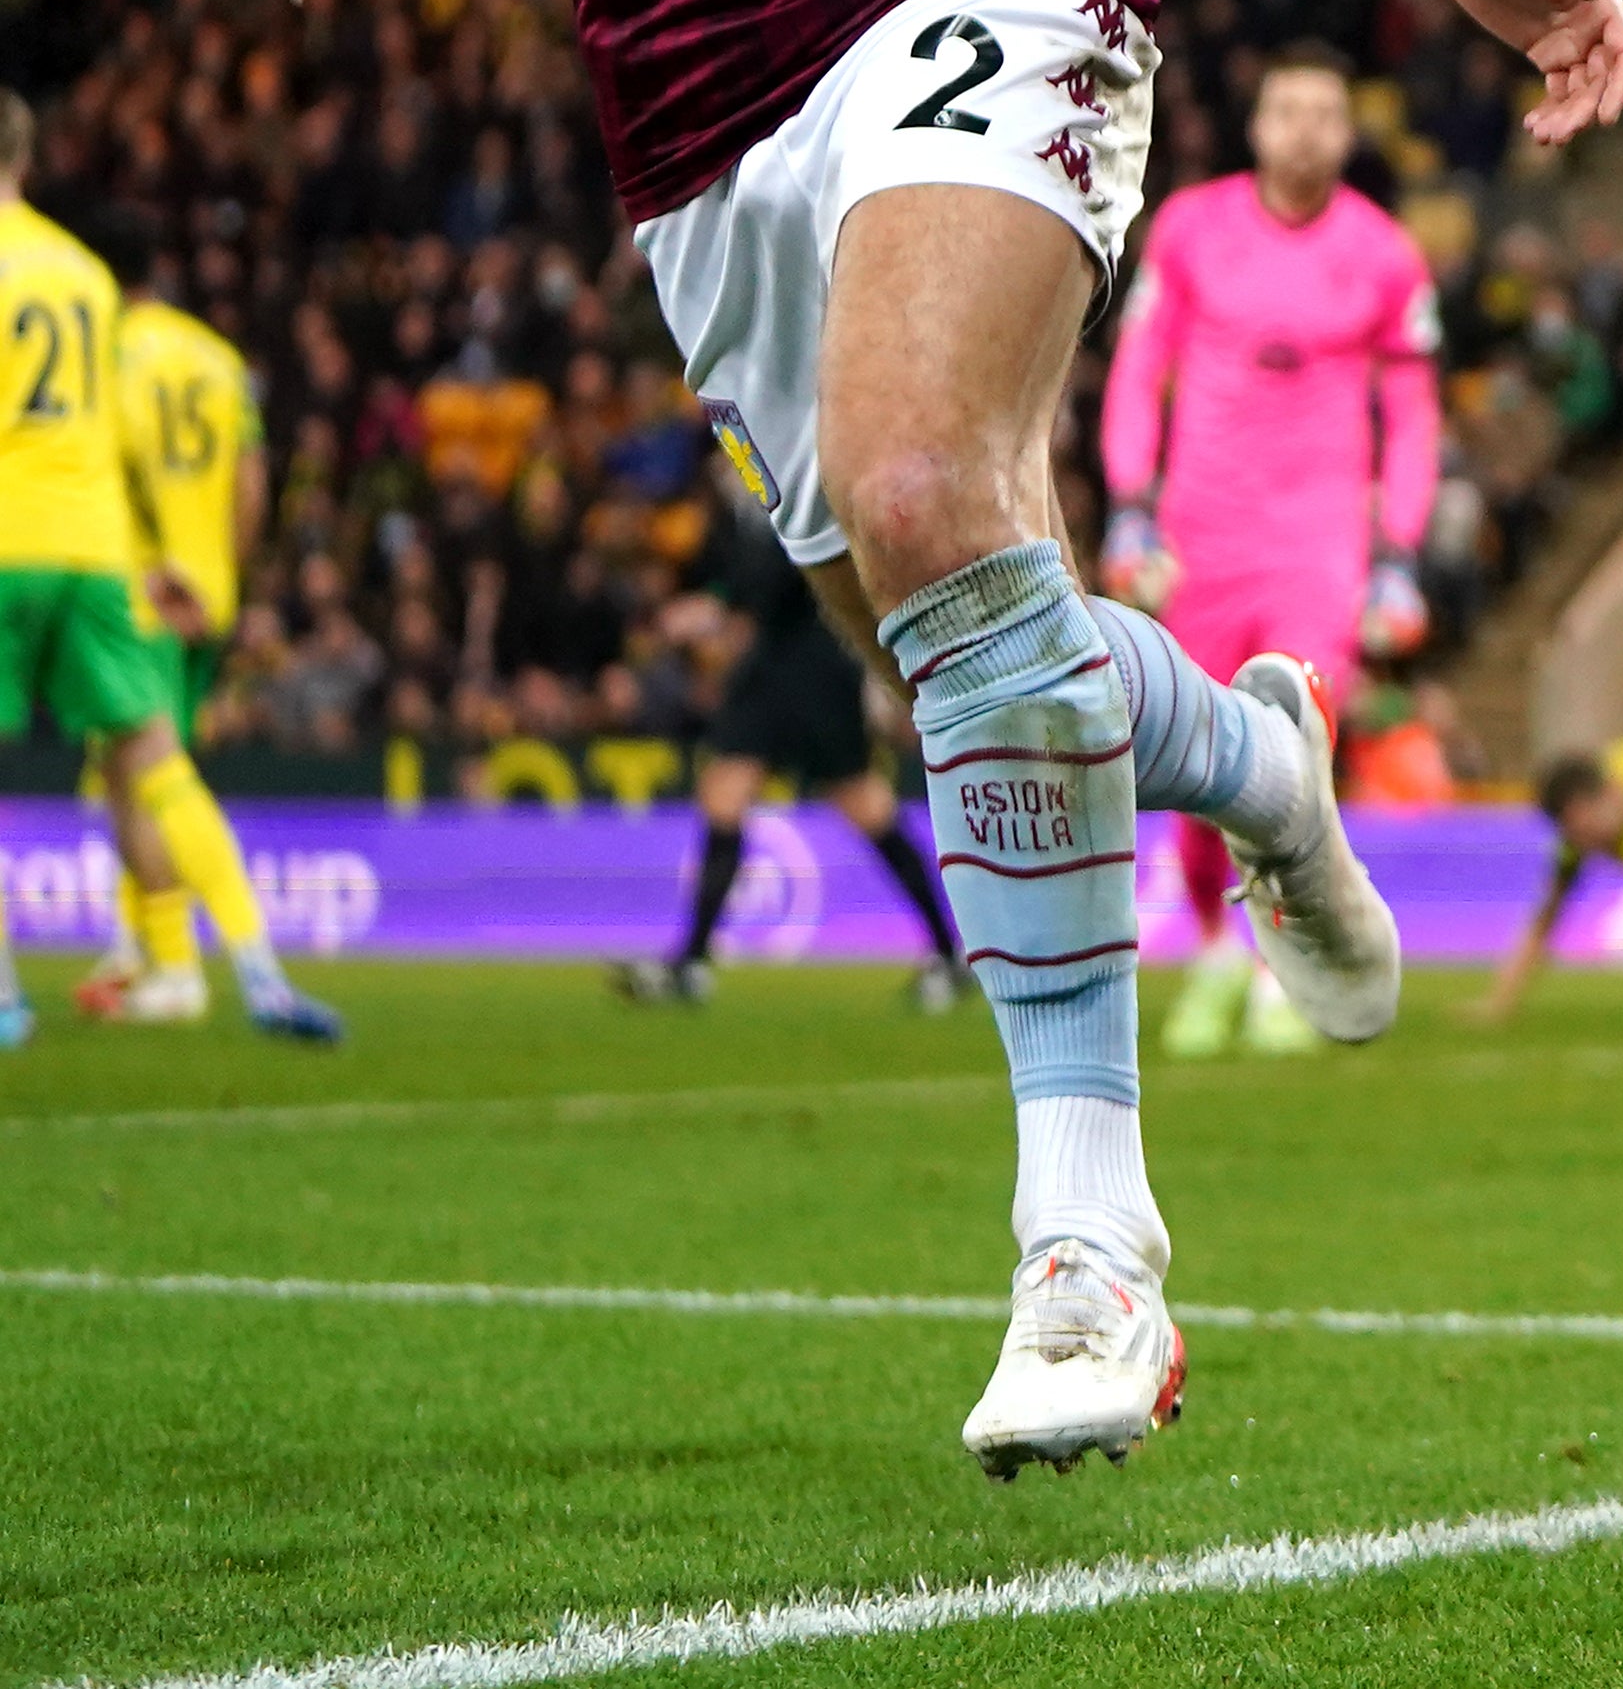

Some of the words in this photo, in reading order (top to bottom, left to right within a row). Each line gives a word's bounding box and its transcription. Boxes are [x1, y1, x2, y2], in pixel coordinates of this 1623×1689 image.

[892, 13, 1005, 136] 2
[15, 297, 97, 416] 21
[965, 812, 1074, 852] VILLA
